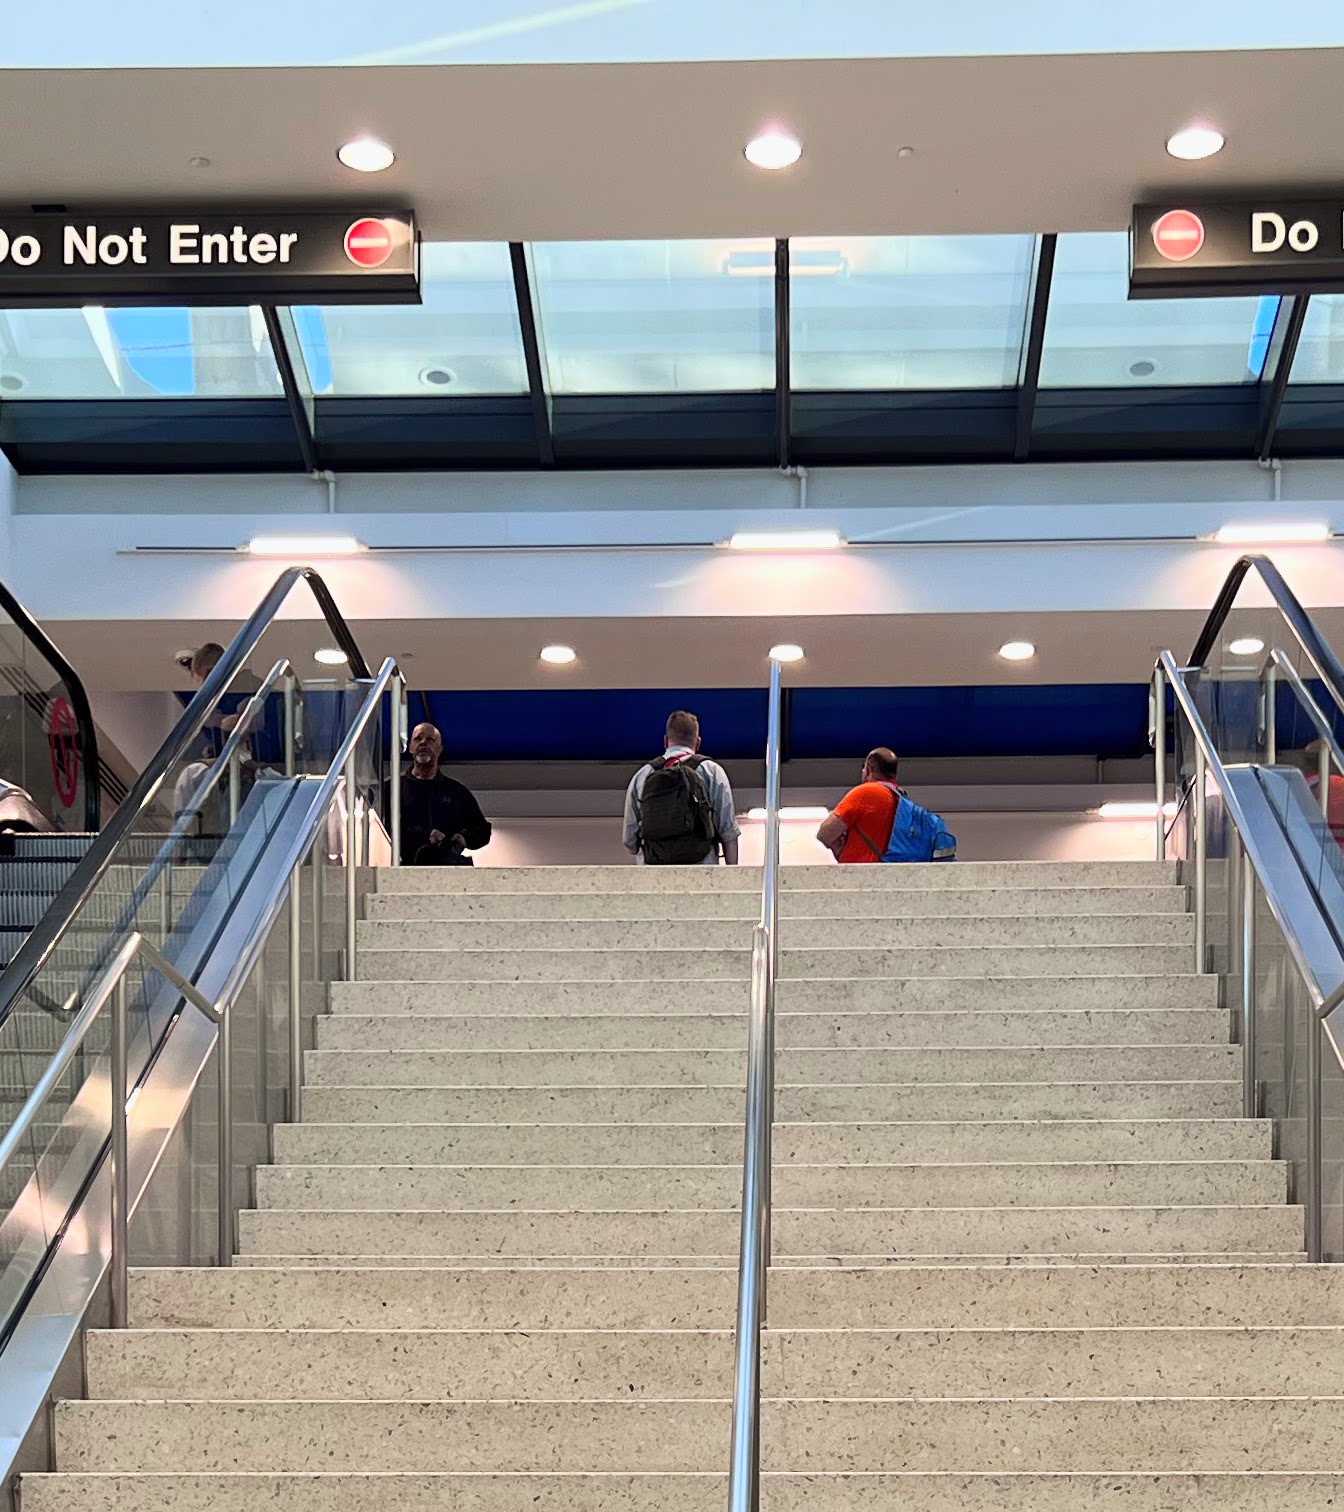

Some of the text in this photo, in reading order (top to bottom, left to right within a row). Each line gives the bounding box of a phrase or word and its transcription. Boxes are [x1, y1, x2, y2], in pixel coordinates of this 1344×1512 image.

[63, 225, 147, 265] Not
[170, 224, 298, 264] Enter
[1251, 212, 1319, 253] Do
